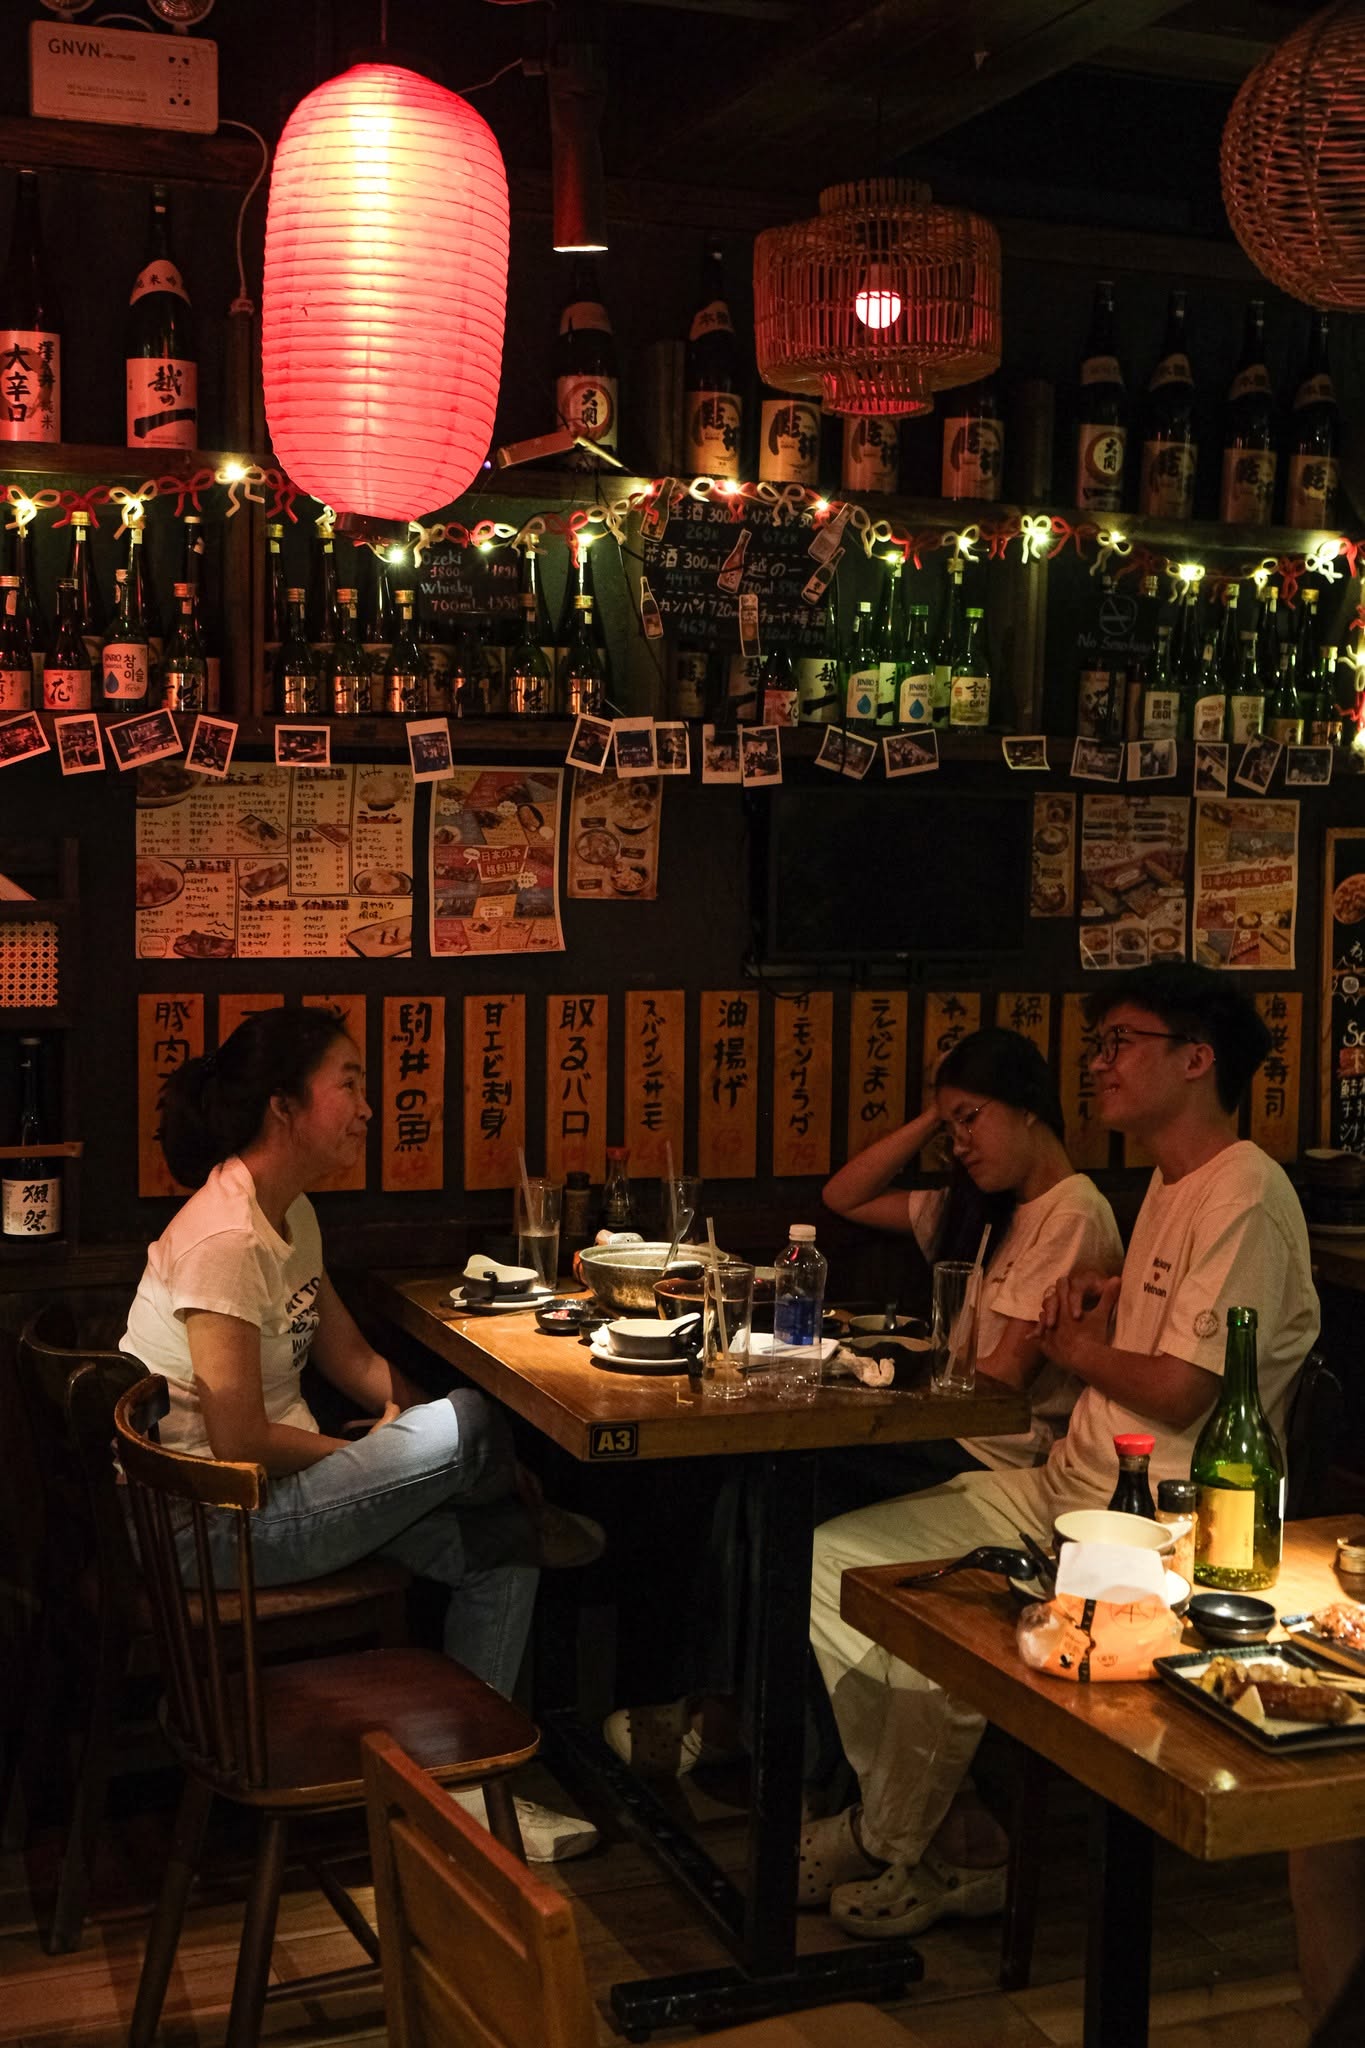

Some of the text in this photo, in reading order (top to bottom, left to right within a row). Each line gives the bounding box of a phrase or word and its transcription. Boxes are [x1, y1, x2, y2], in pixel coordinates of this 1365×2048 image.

[48, 38, 100, 57] GNVN
[4, 343, 32, 422] 大辛口
[420, 580, 473, 598] Whisky
[659, 597, 706, 615] カンパイ
[1076, 632, 1097, 649] No
[857, 678, 875, 687] JINRO
[909, 683, 927, 692] JINRO
[481, 847, 521, 862] 日本の本
[712, 996, 748, 1111] 油揚げ
[860, 998, 897, 1122] えだまめ
[480, 1002, 512, 1140] 甘エビ刺身
[597, 1430, 631, 1452] A3
